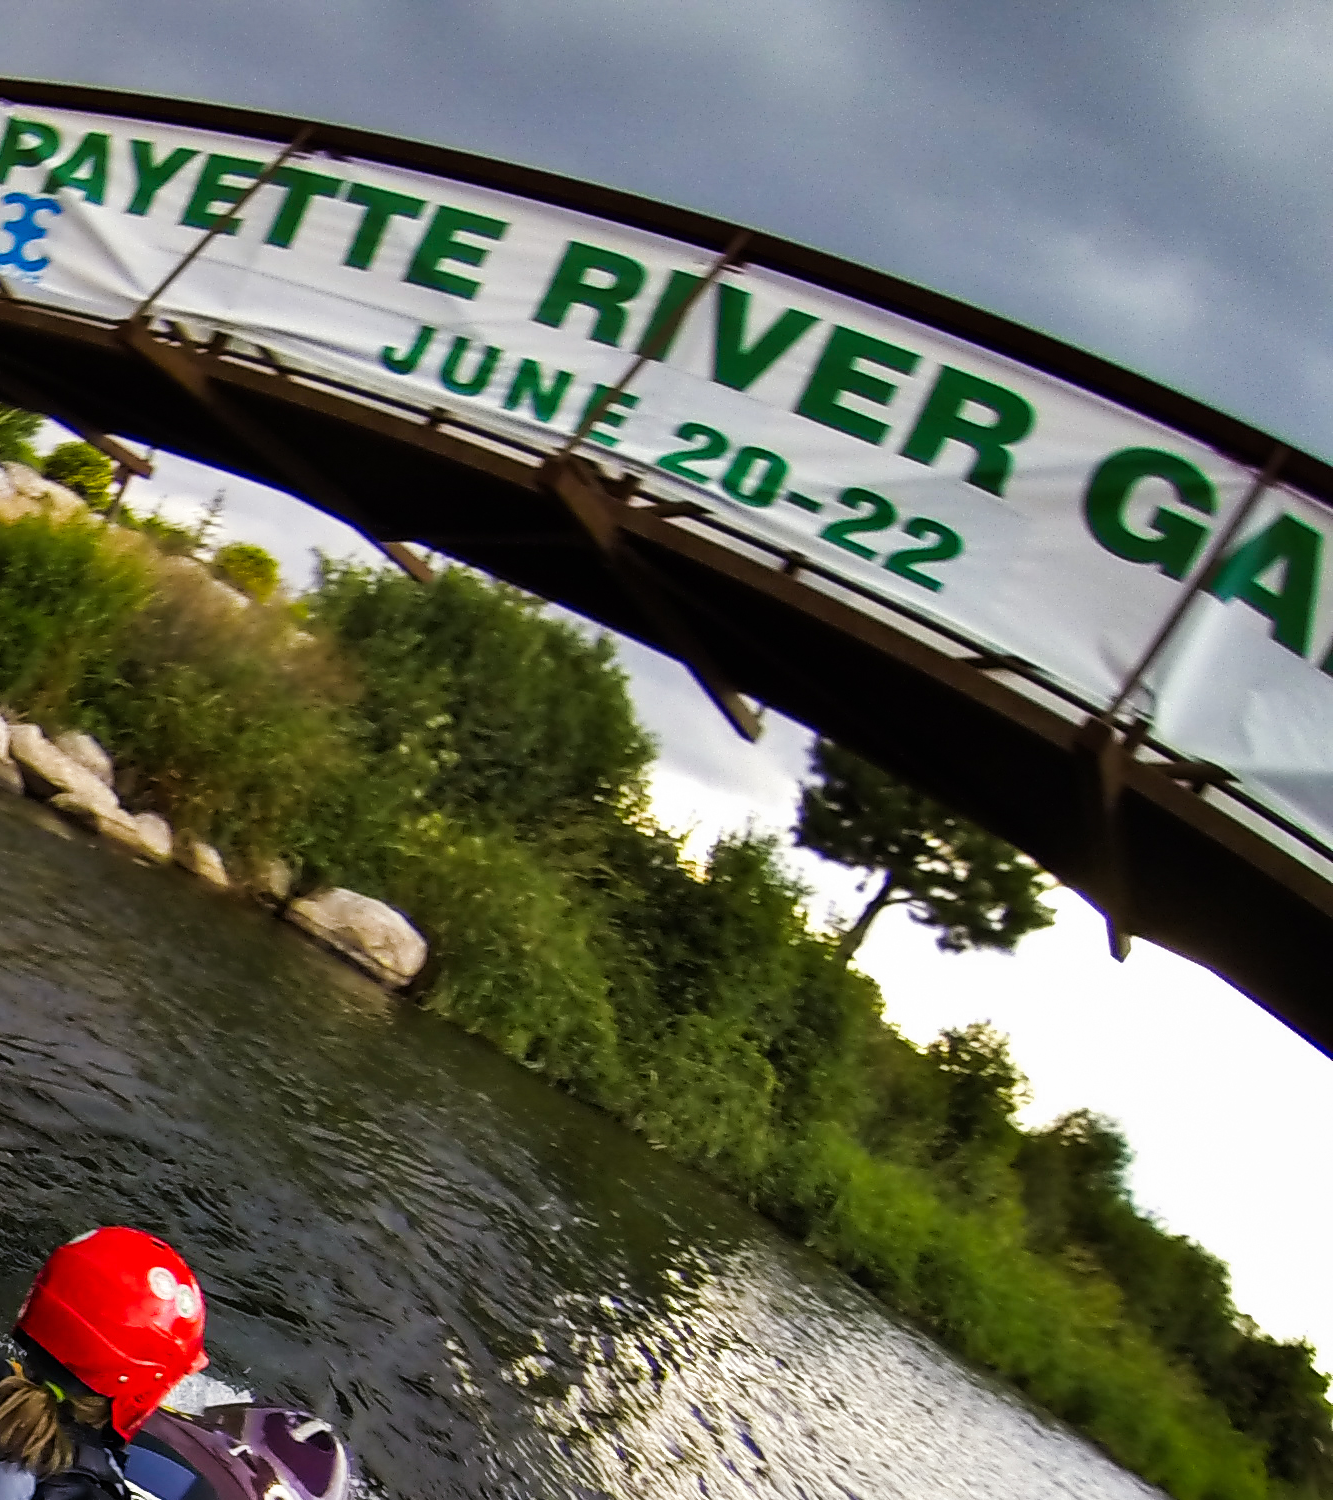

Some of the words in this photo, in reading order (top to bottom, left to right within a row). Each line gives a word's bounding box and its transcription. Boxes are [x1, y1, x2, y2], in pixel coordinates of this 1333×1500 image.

[379, 325, 640, 449] JUNE
[657, 422, 965, 593] 20-22
[536, 240, 1036, 498] RIVER
[1081, 446, 1333, 678] GA
